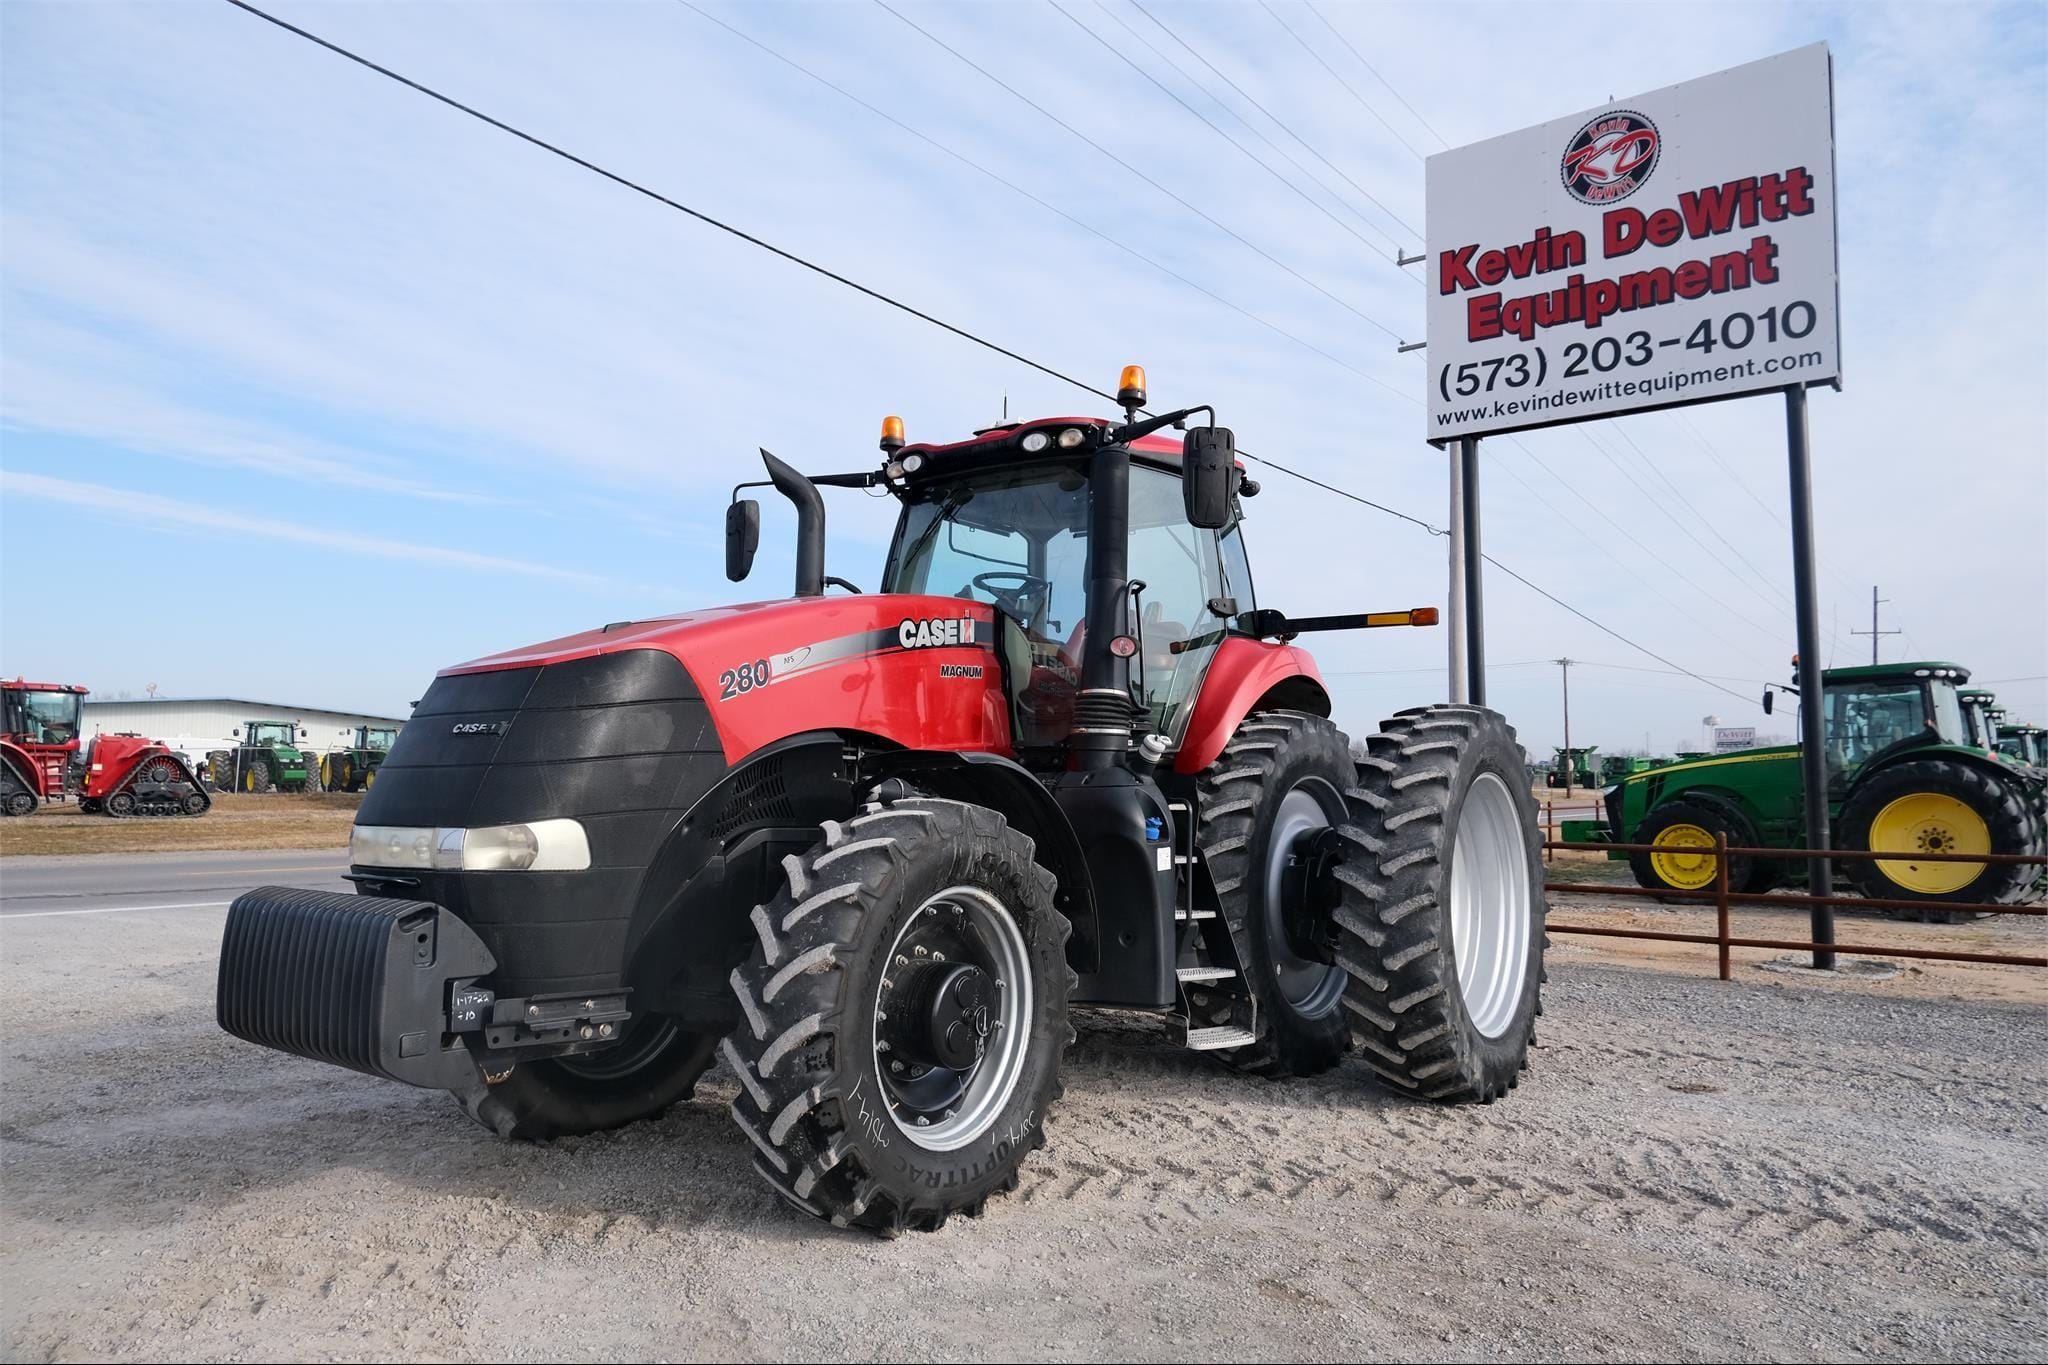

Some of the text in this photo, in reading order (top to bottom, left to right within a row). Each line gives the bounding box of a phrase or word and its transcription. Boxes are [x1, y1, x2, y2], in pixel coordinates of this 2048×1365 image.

[1588, 117, 1630, 138] Kevin
[1564, 129, 1658, 187] KD
[1586, 176, 1637, 200] DeWitt
[1440, 166, 1815, 295] Kevin DeWitt
[1467, 235, 1780, 342] Equipment
[1439, 300, 1817, 402] (573) 203-4010
[1437, 350, 1823, 425] www.kevindewittequipment.com
[719, 659, 769, 701] 280
[939, 663, 983, 679] MAGNUM
[894, 1141, 1009, 1189] OPTITRAC
